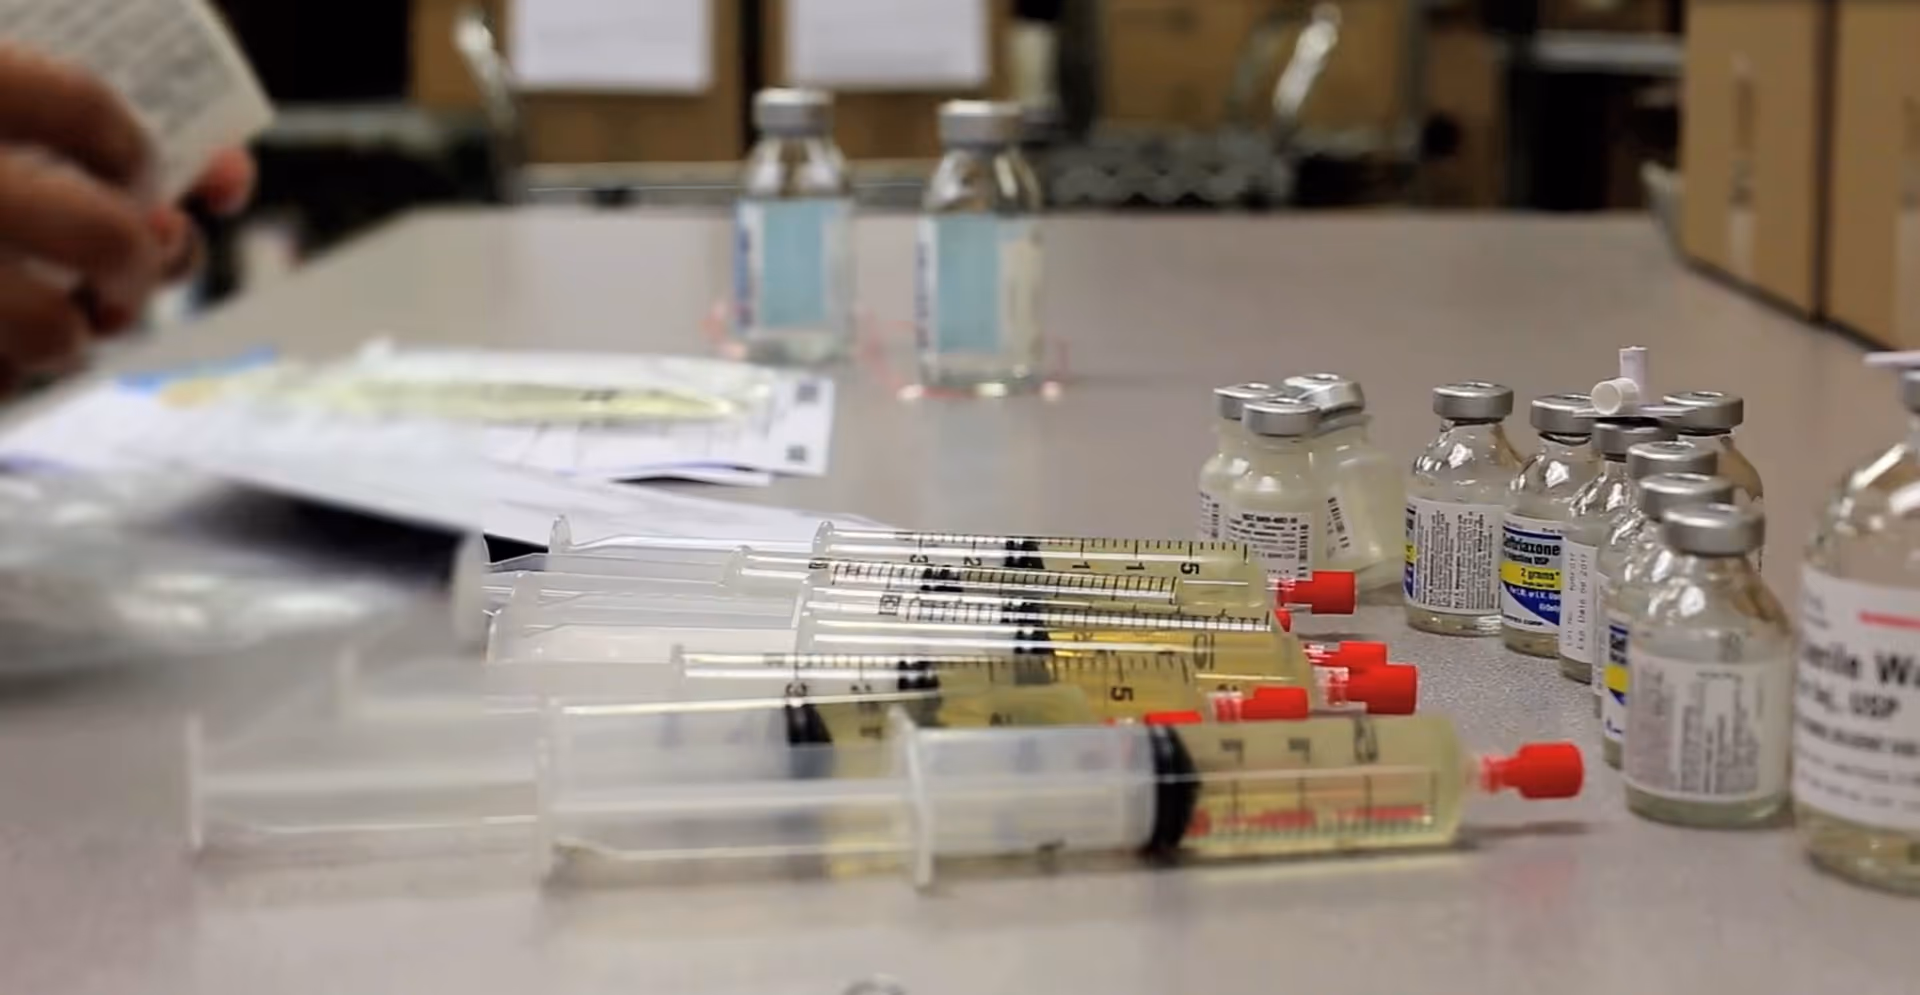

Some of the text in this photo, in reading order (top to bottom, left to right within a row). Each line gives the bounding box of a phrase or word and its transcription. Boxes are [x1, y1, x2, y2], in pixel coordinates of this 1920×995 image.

[1180, 561, 1200, 576] 5
[1520, 567, 1526, 577] 2
[1110, 685, 1134, 702] 5
